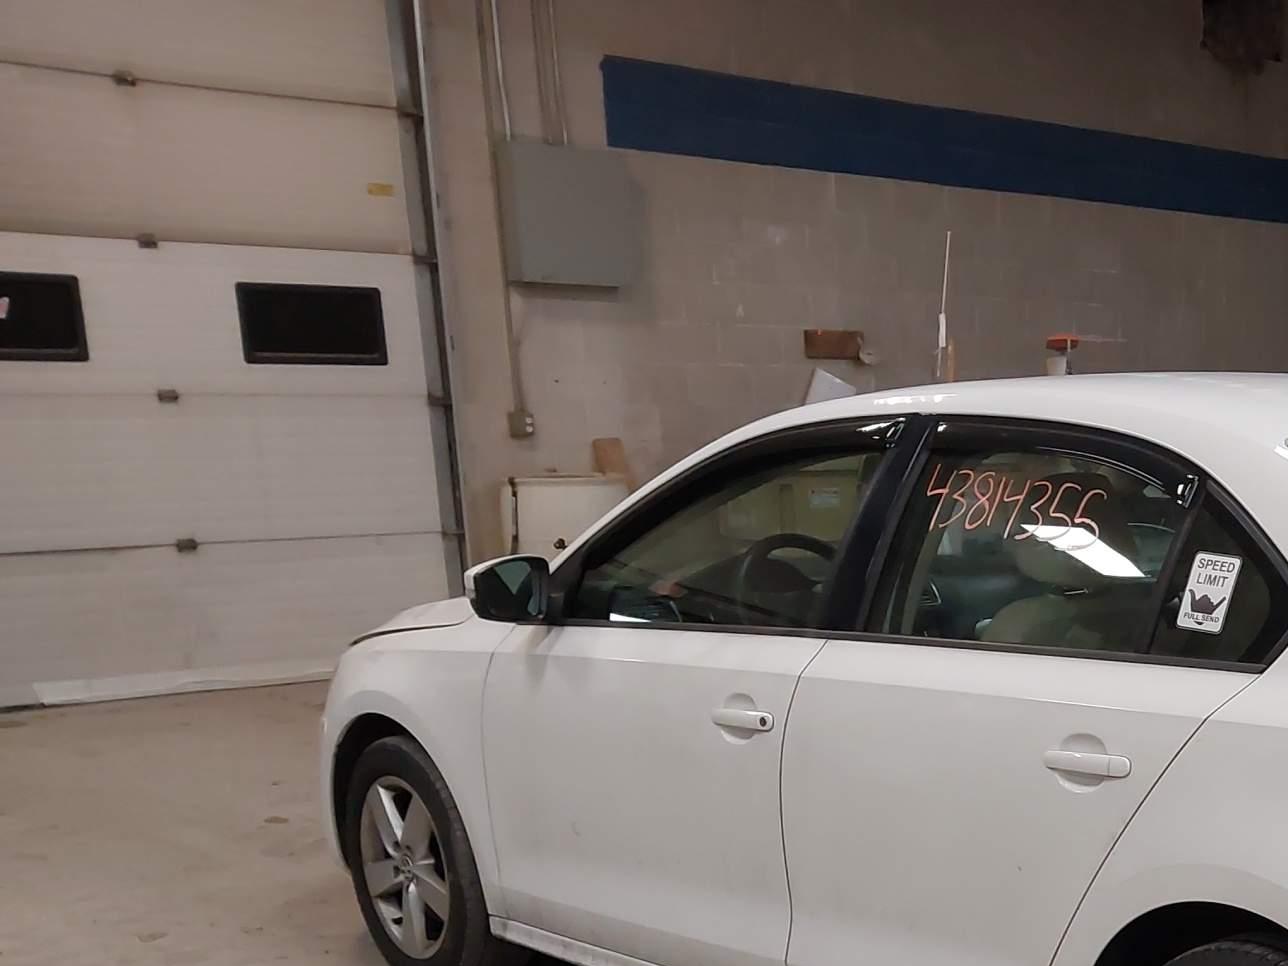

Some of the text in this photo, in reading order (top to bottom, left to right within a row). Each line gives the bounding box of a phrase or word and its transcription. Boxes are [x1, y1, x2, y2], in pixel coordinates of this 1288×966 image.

[1197, 558, 1236, 573] SPEED
[1196, 572, 1229, 588] LIMIT
[1183, 611, 1220, 623] FULL SEND
